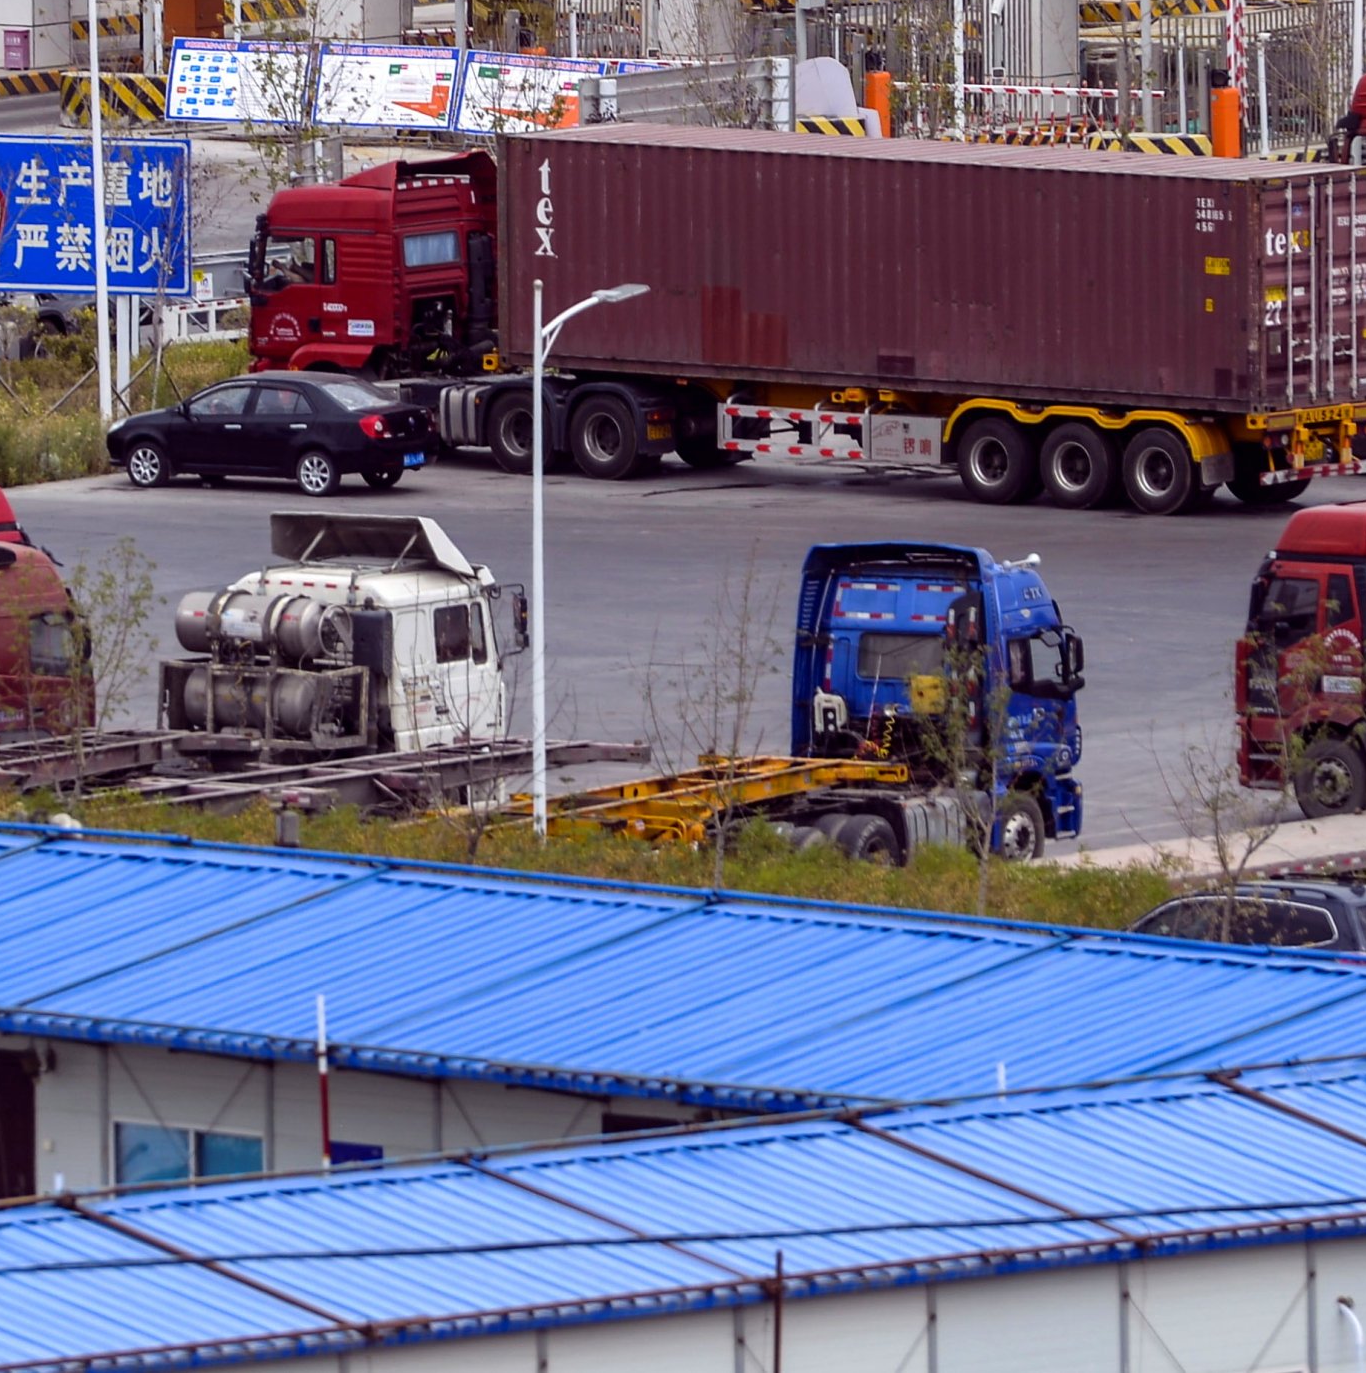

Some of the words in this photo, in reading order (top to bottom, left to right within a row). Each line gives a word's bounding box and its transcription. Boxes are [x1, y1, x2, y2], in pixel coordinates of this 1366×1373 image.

[15, 158, 173, 208] 生产重地
[13, 222, 175, 275] 严禁烟火
